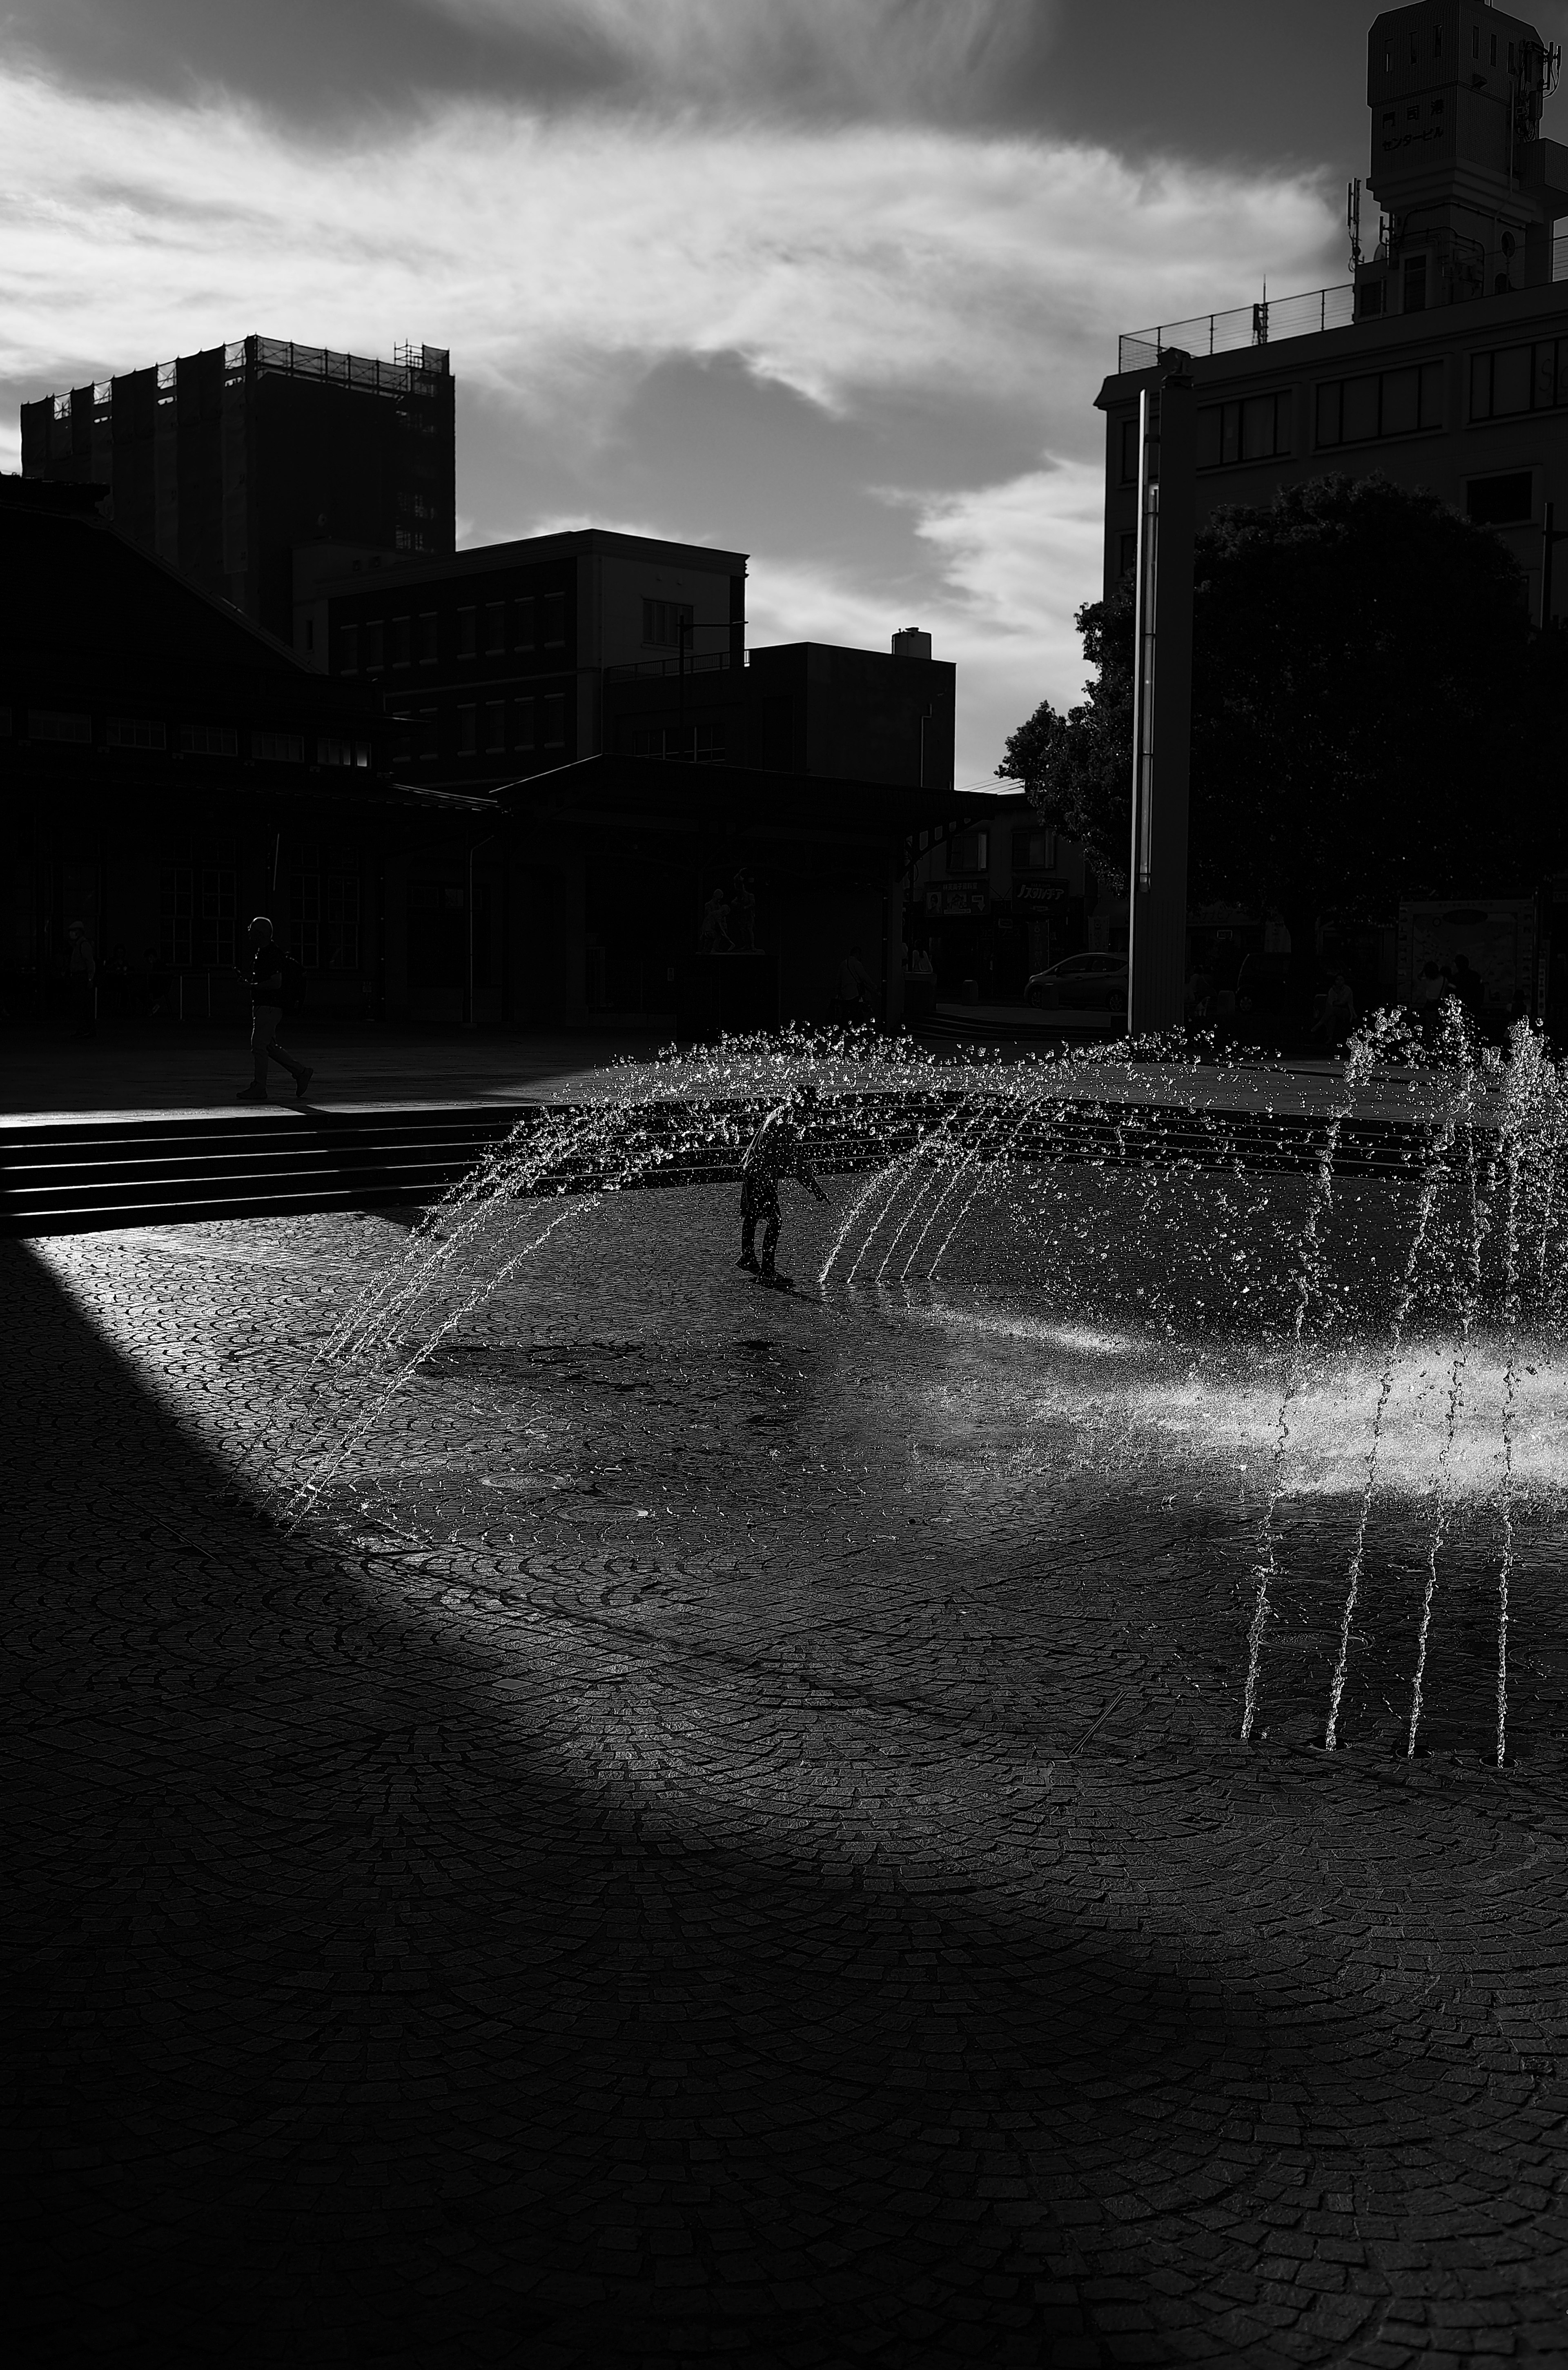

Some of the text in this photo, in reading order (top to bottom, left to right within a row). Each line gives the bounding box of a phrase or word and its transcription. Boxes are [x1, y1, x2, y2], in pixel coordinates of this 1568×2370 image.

[1383, 98, 1444, 129] 門司港
[1382, 126, 1444, 151] センタービル
